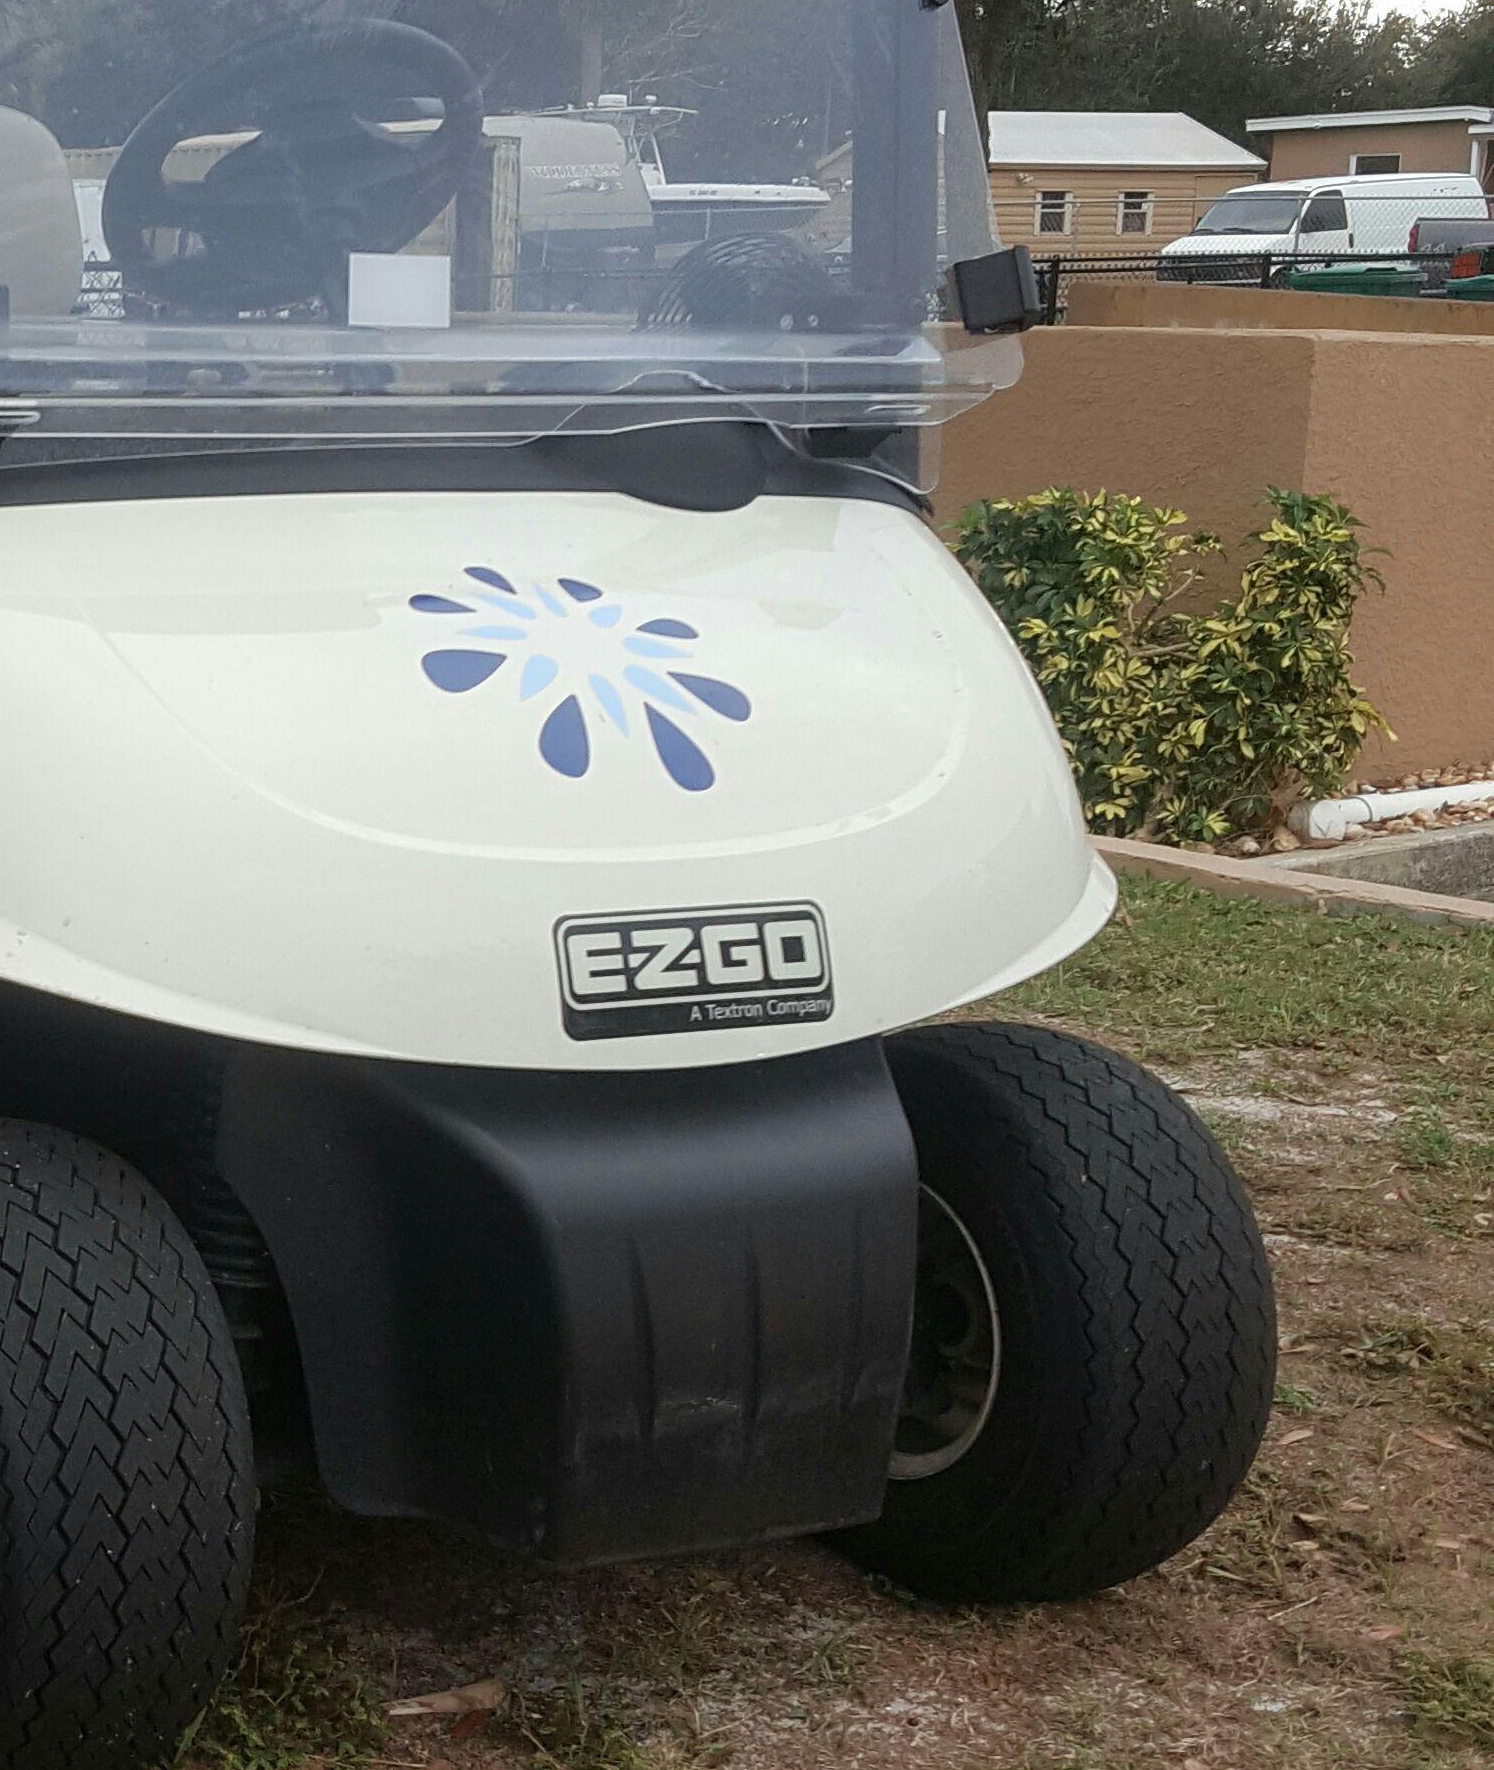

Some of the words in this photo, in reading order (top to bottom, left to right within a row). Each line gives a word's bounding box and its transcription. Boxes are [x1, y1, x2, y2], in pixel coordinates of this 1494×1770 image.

[566, 918, 823, 996] EZGO
[690, 1004, 703, 1021] A
[705, 1003, 764, 1020] Textron
[766, 999, 832, 1017] Company
